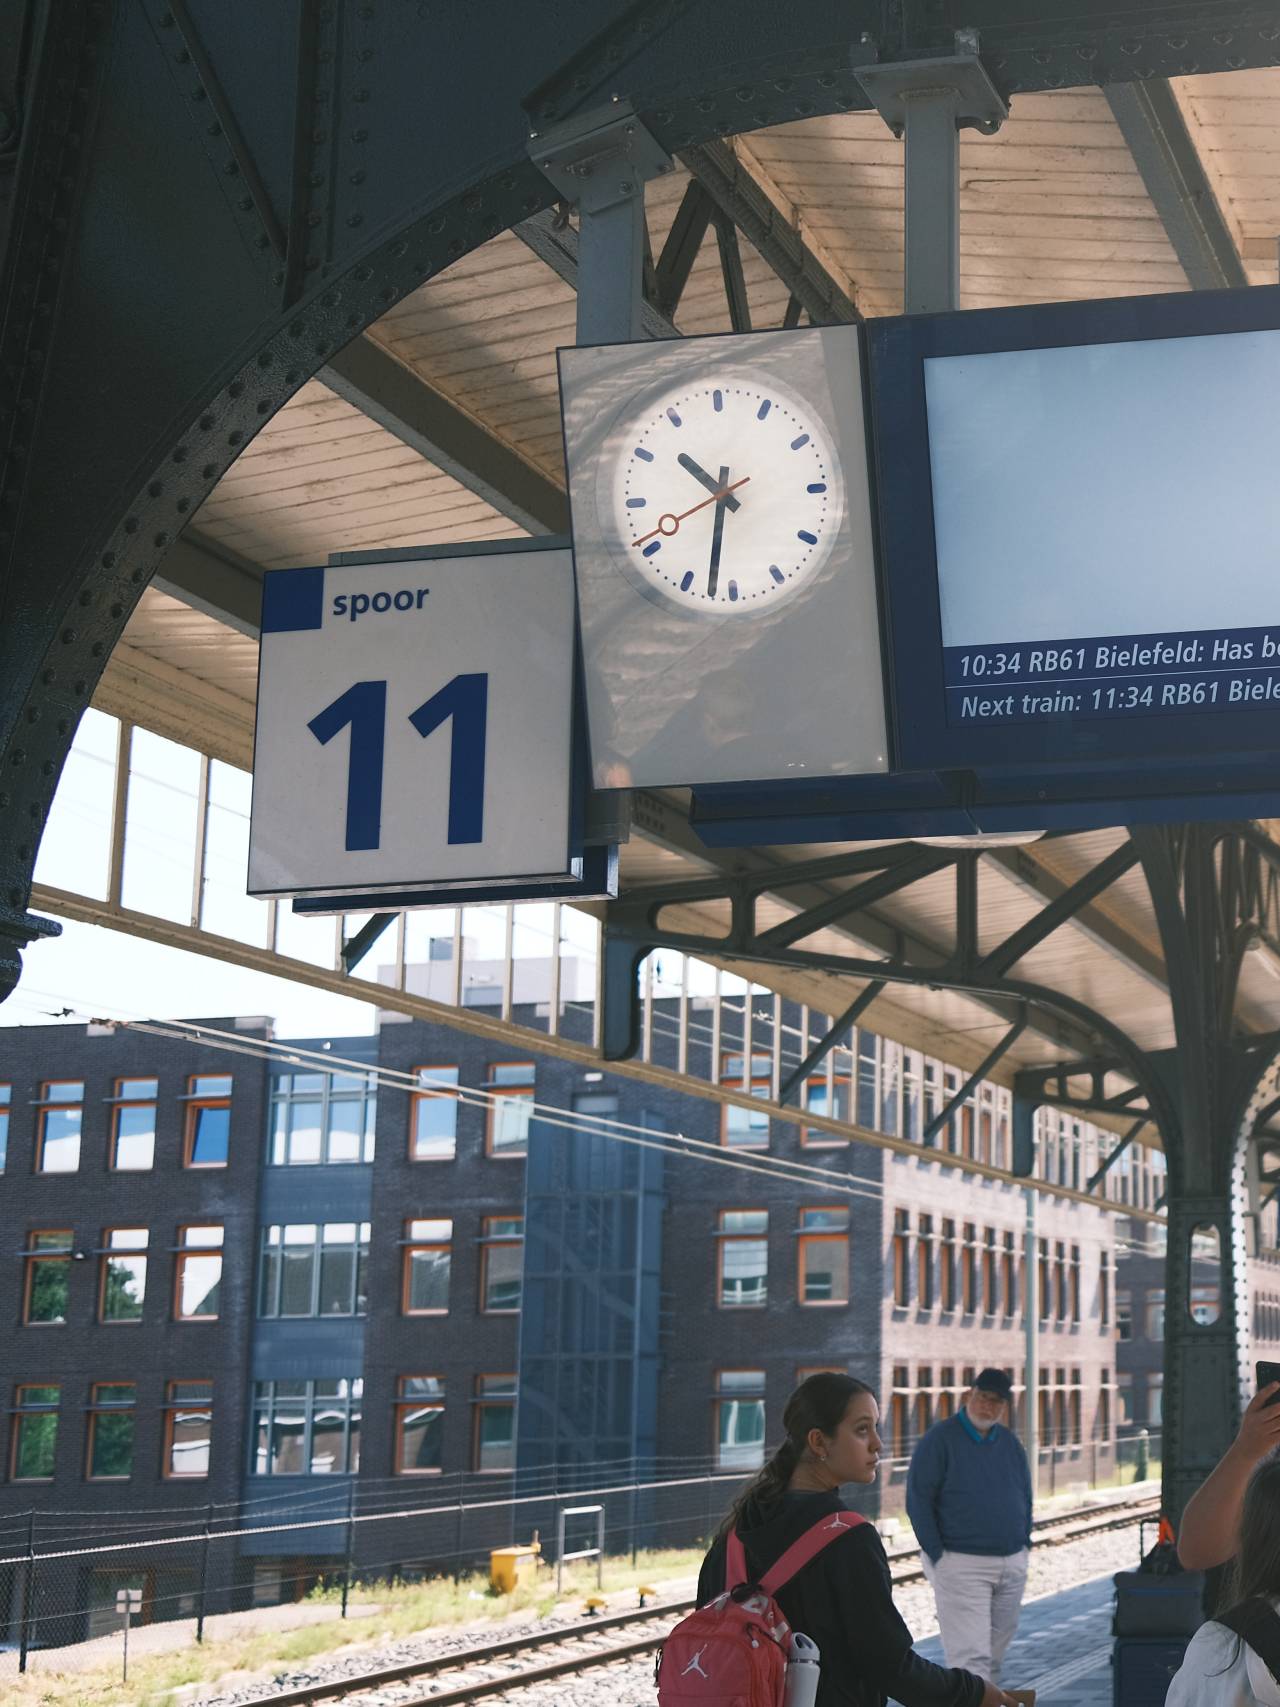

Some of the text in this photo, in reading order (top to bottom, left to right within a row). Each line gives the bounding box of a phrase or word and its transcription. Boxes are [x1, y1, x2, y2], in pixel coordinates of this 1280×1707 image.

[332, 588, 430, 621] spoor
[960, 652, 1021, 677] 10:34
[1028, 649, 1085, 673] RB61
[1095, 639, 1204, 669] Bielefeld:
[1212, 639, 1254, 661] Has
[961, 695, 1014, 717] Next
[1022, 690, 1082, 714] train:
[1092, 685, 1153, 710] 11:34
[1161, 681, 1219, 706] RB61
[307, 672, 488, 851] 11
